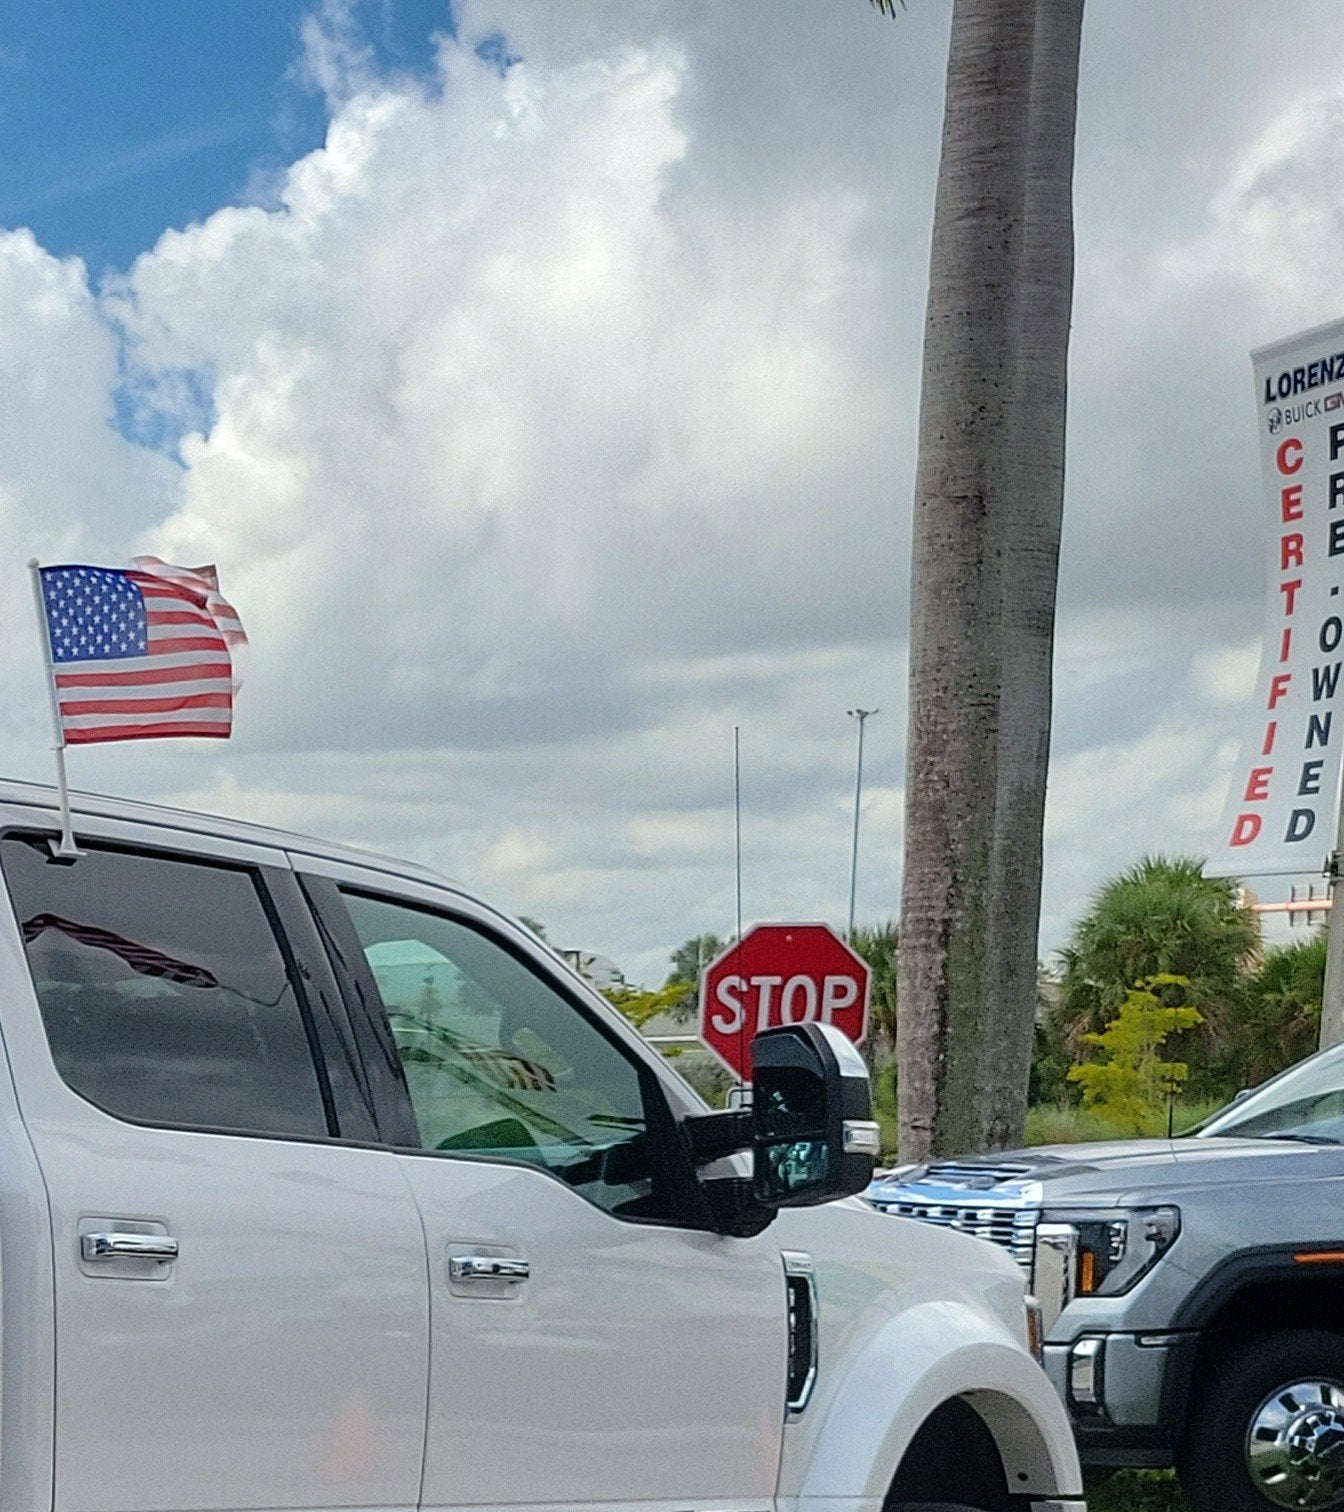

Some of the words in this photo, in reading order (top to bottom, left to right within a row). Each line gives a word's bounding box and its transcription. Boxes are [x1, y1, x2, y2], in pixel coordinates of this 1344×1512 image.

[1285, 399, 1322, 425] BUICK
[1229, 438, 1304, 847] CERTIFIED
[712, 974, 858, 1034] STOP
